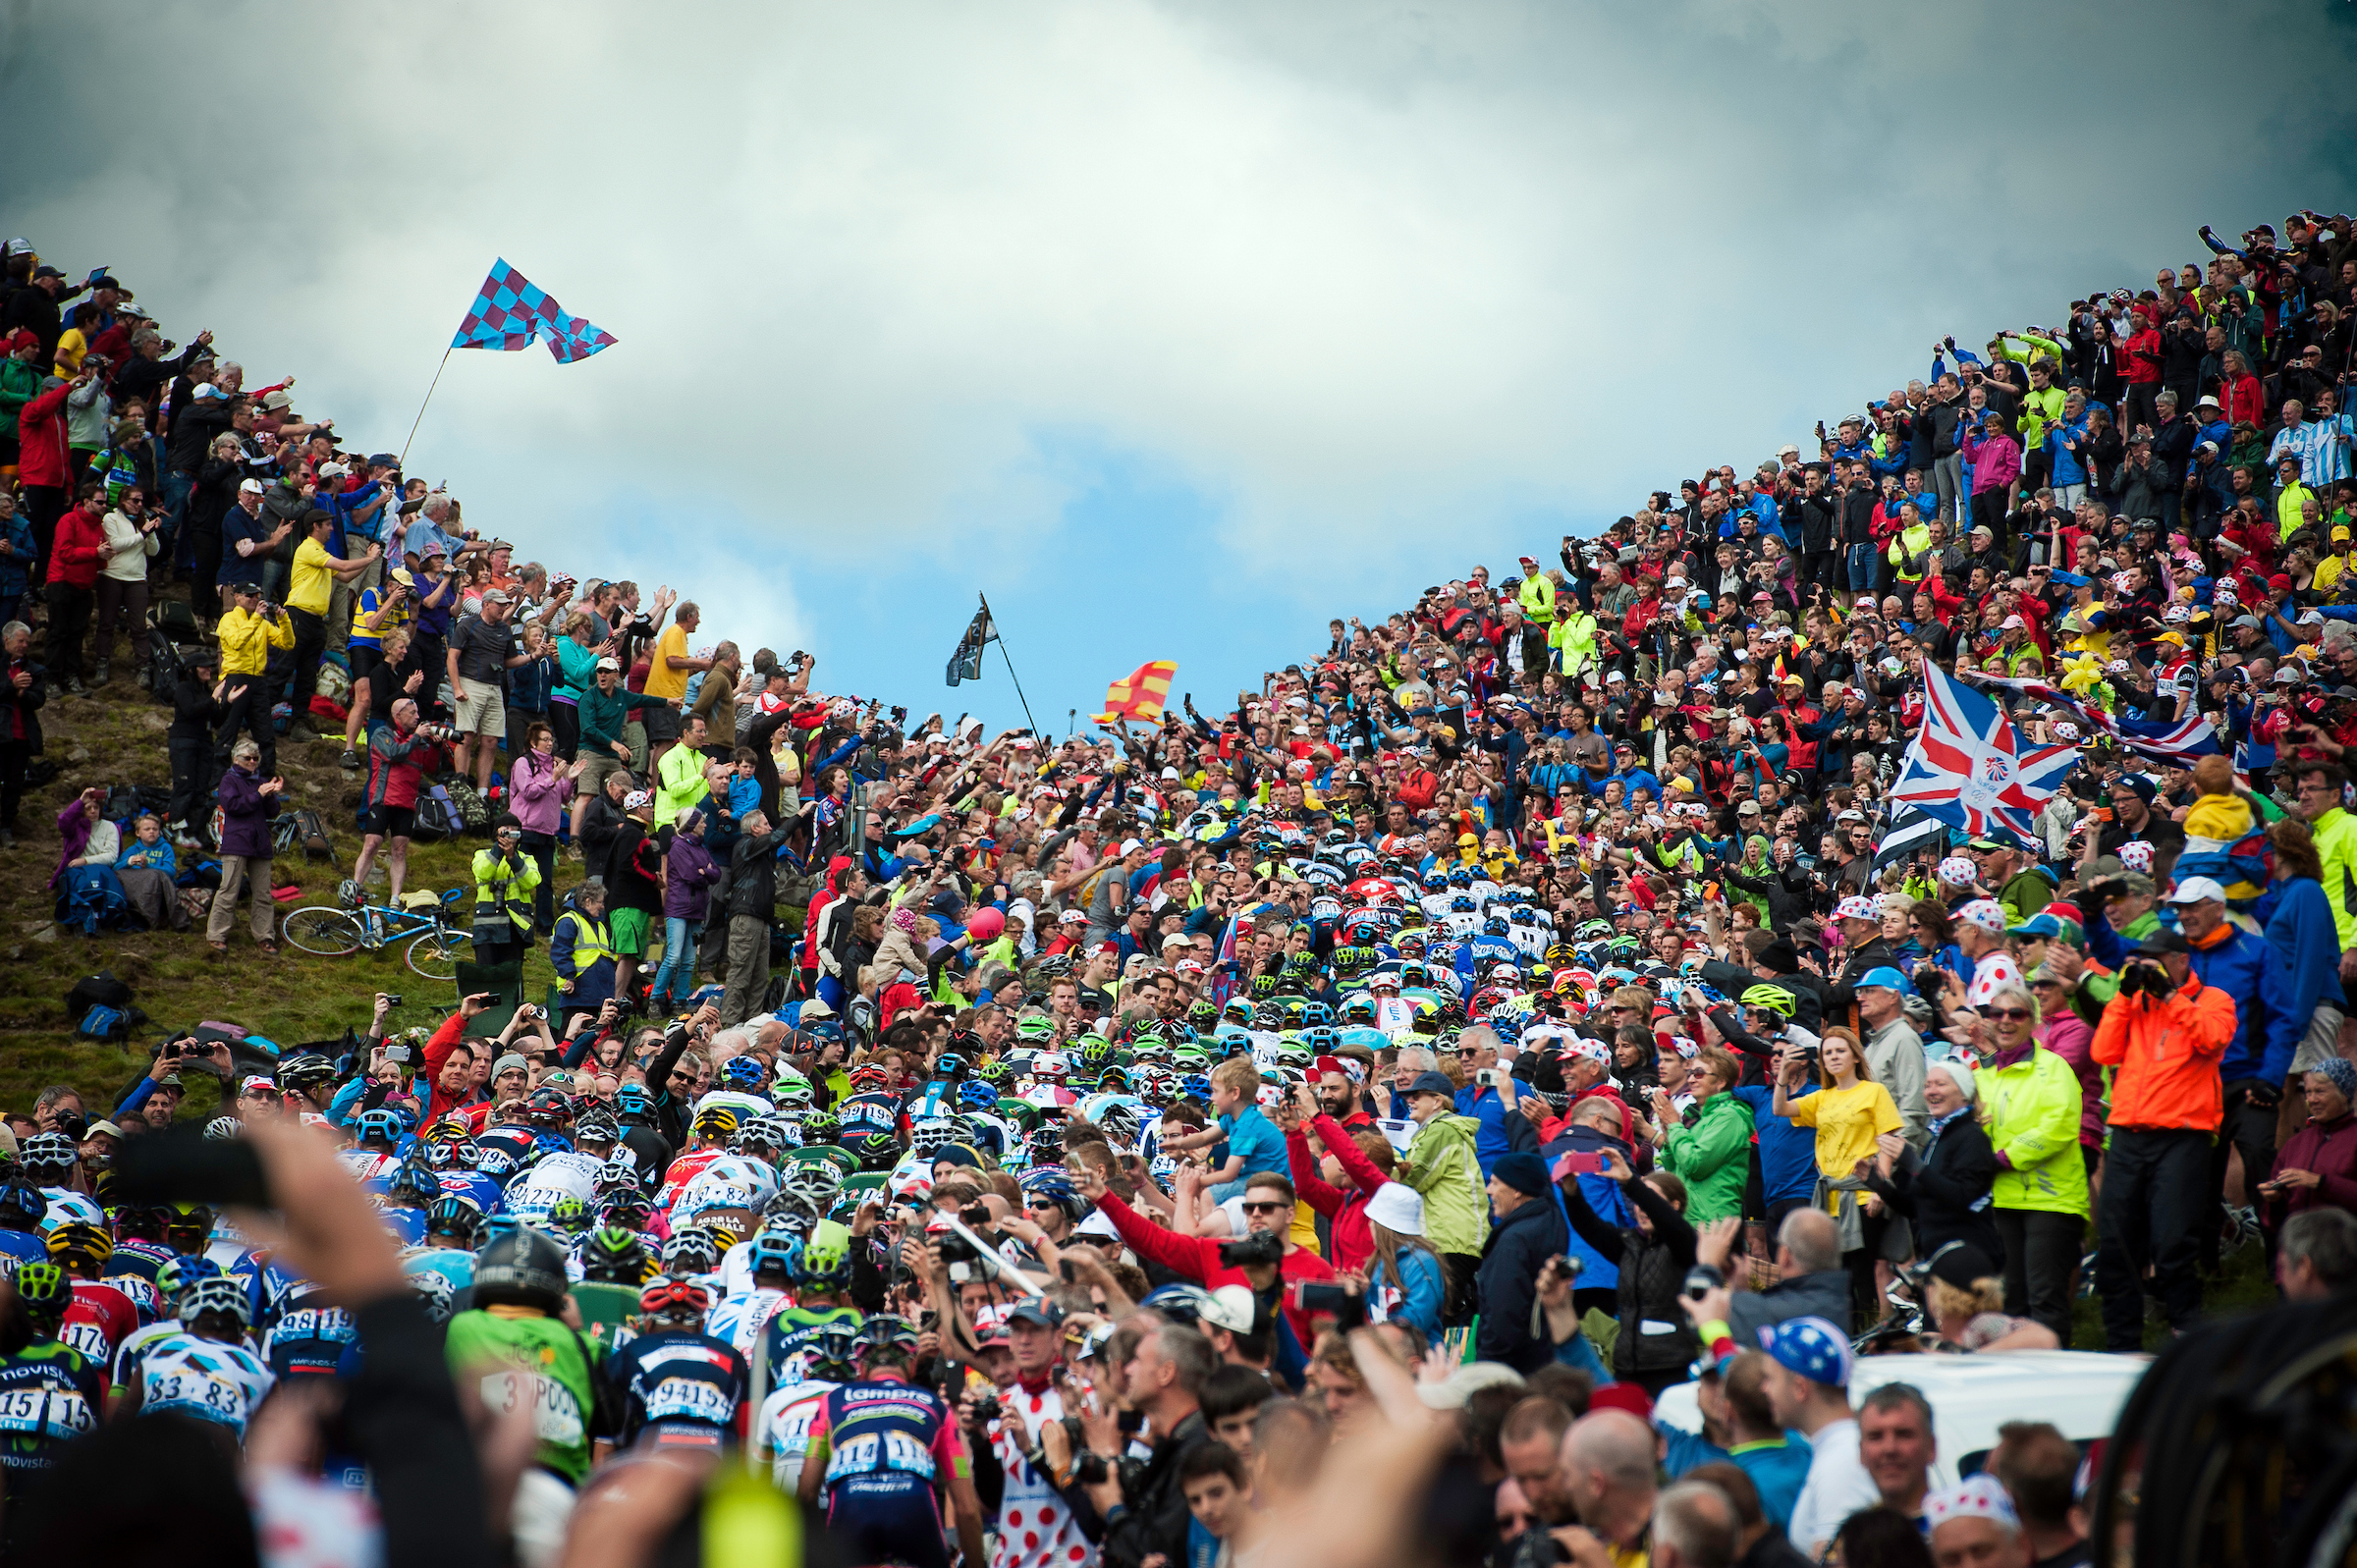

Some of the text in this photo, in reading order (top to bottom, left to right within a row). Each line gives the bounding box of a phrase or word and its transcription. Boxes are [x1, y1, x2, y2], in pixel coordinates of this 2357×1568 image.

[1340, 988, 1370, 1000] movist
[726, 1186, 746, 1202] 82
[725, 1216, 740, 1225] LA
[745, 1295, 780, 1338] GARMIN
[70, 1325, 109, 1358] 179
[147, 1376, 182, 1404] 83
[204, 1380, 237, 1415] 83
[0, 1392, 92, 1433] 15 15
[346, 1472, 366, 1484] FD
